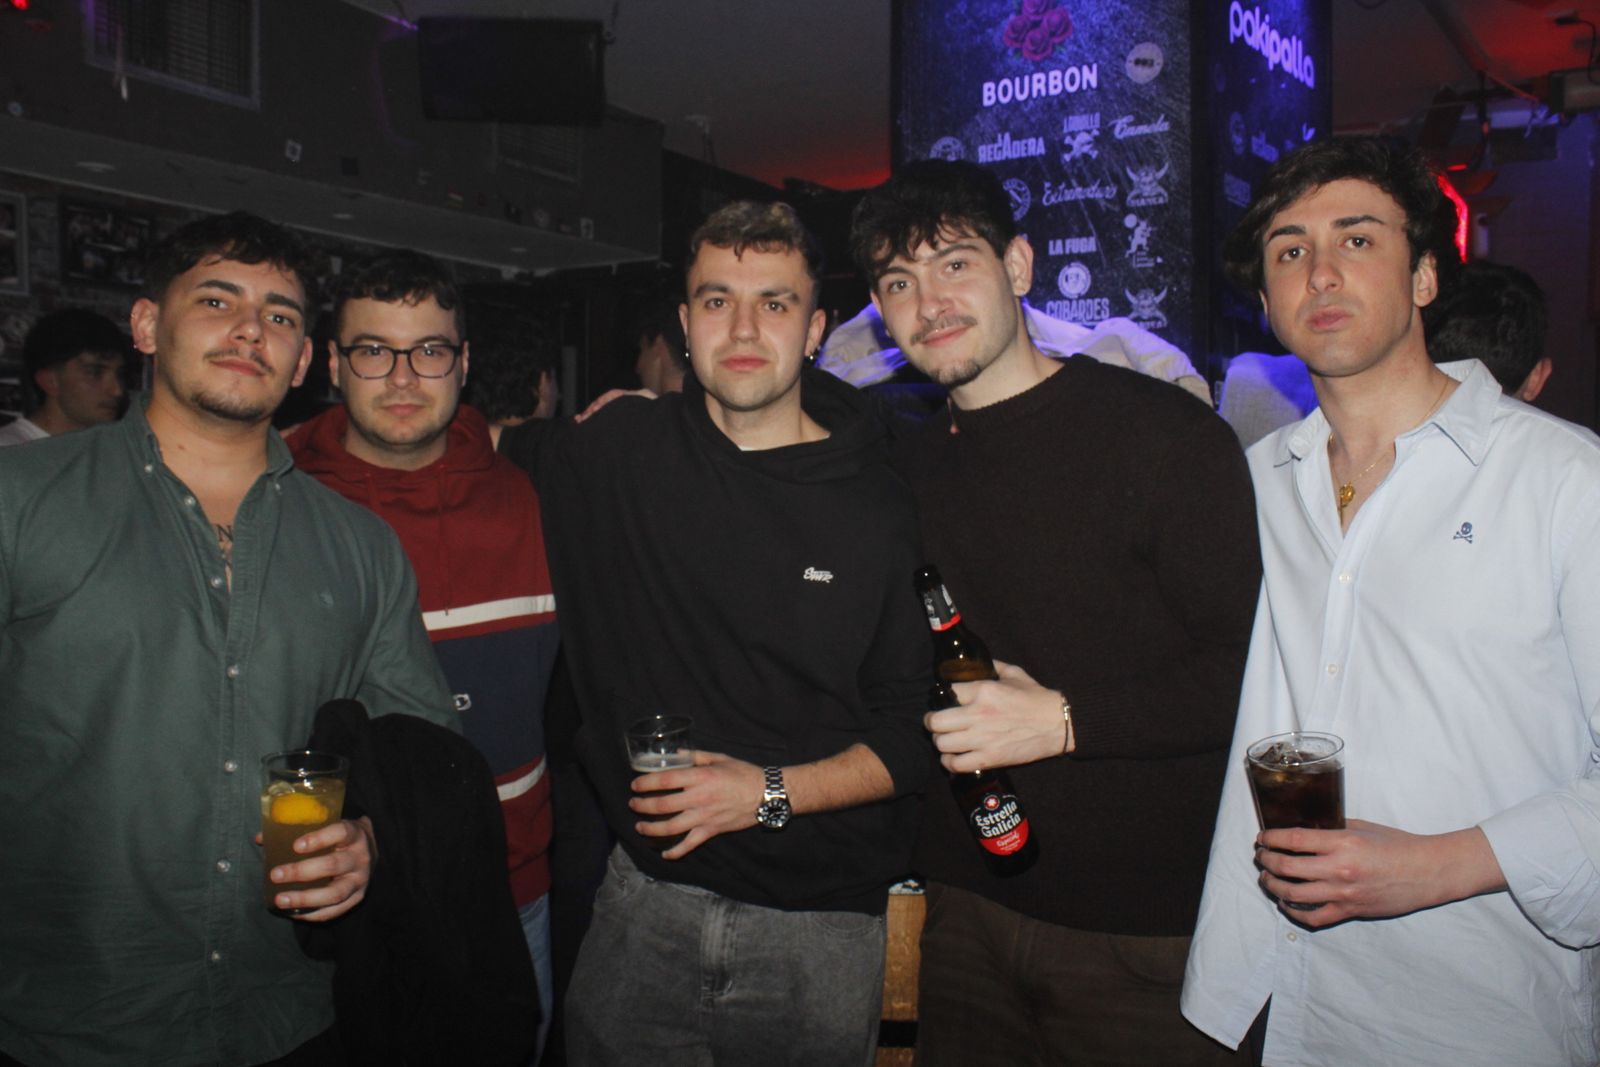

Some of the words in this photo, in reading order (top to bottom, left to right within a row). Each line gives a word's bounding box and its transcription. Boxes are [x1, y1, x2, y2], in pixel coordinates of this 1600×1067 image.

[1228, 0, 1316, 90] pakipalla
[982, 63, 1098, 107] BOURBON
[977, 132, 1046, 164] REGADERA
[1048, 239, 1064, 256] LA
[1065, 236, 1098, 254] FUGA
[974, 801, 1019, 826] Estrella
[980, 813, 1022, 838] Galicia
